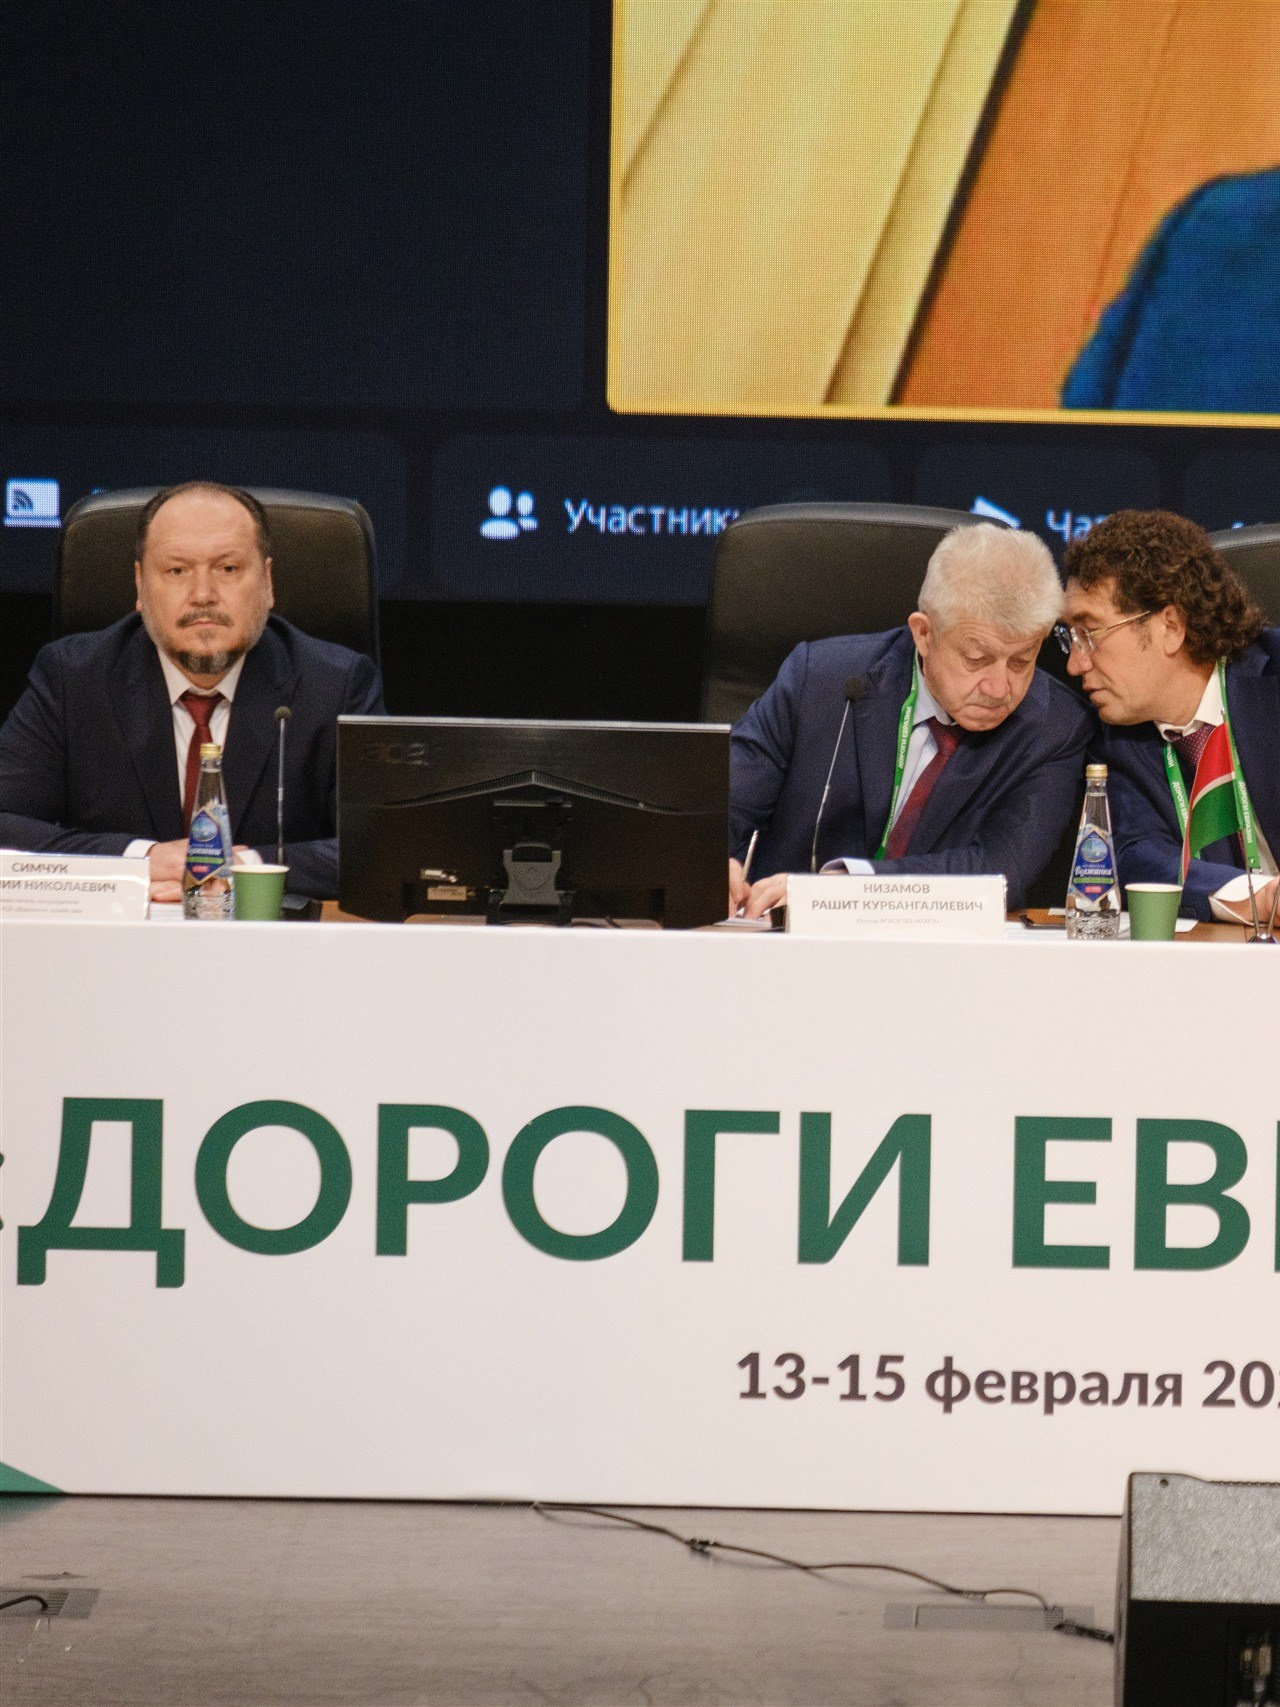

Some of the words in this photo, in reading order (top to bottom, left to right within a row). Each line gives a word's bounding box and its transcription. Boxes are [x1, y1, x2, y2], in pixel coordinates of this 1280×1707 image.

[563, 498, 739, 535] Участник
[1172, 781, 1185, 806] ДОРОГИ
[1179, 806, 1189, 828] ЕВРА
[1238, 781, 1248, 811] ДОРОГИ
[1243, 811, 1252, 843] ЕВРАЗИИ
[12, 862, 69, 874] СИМЧУК
[24, 880, 117, 893] НИКОЛАЕВИЧ
[811, 900, 860, 910] РАШИТ
[863, 900, 983, 911] КУРБАНГАЛИЕВИЧ
[863, 883, 930, 894] НИЗАМОВ
[0, 1097, 932, 1288] ДОРОГИ
[737, 1352, 906, 1402] 13-15
[925, 1356, 1183, 1415] февраля
